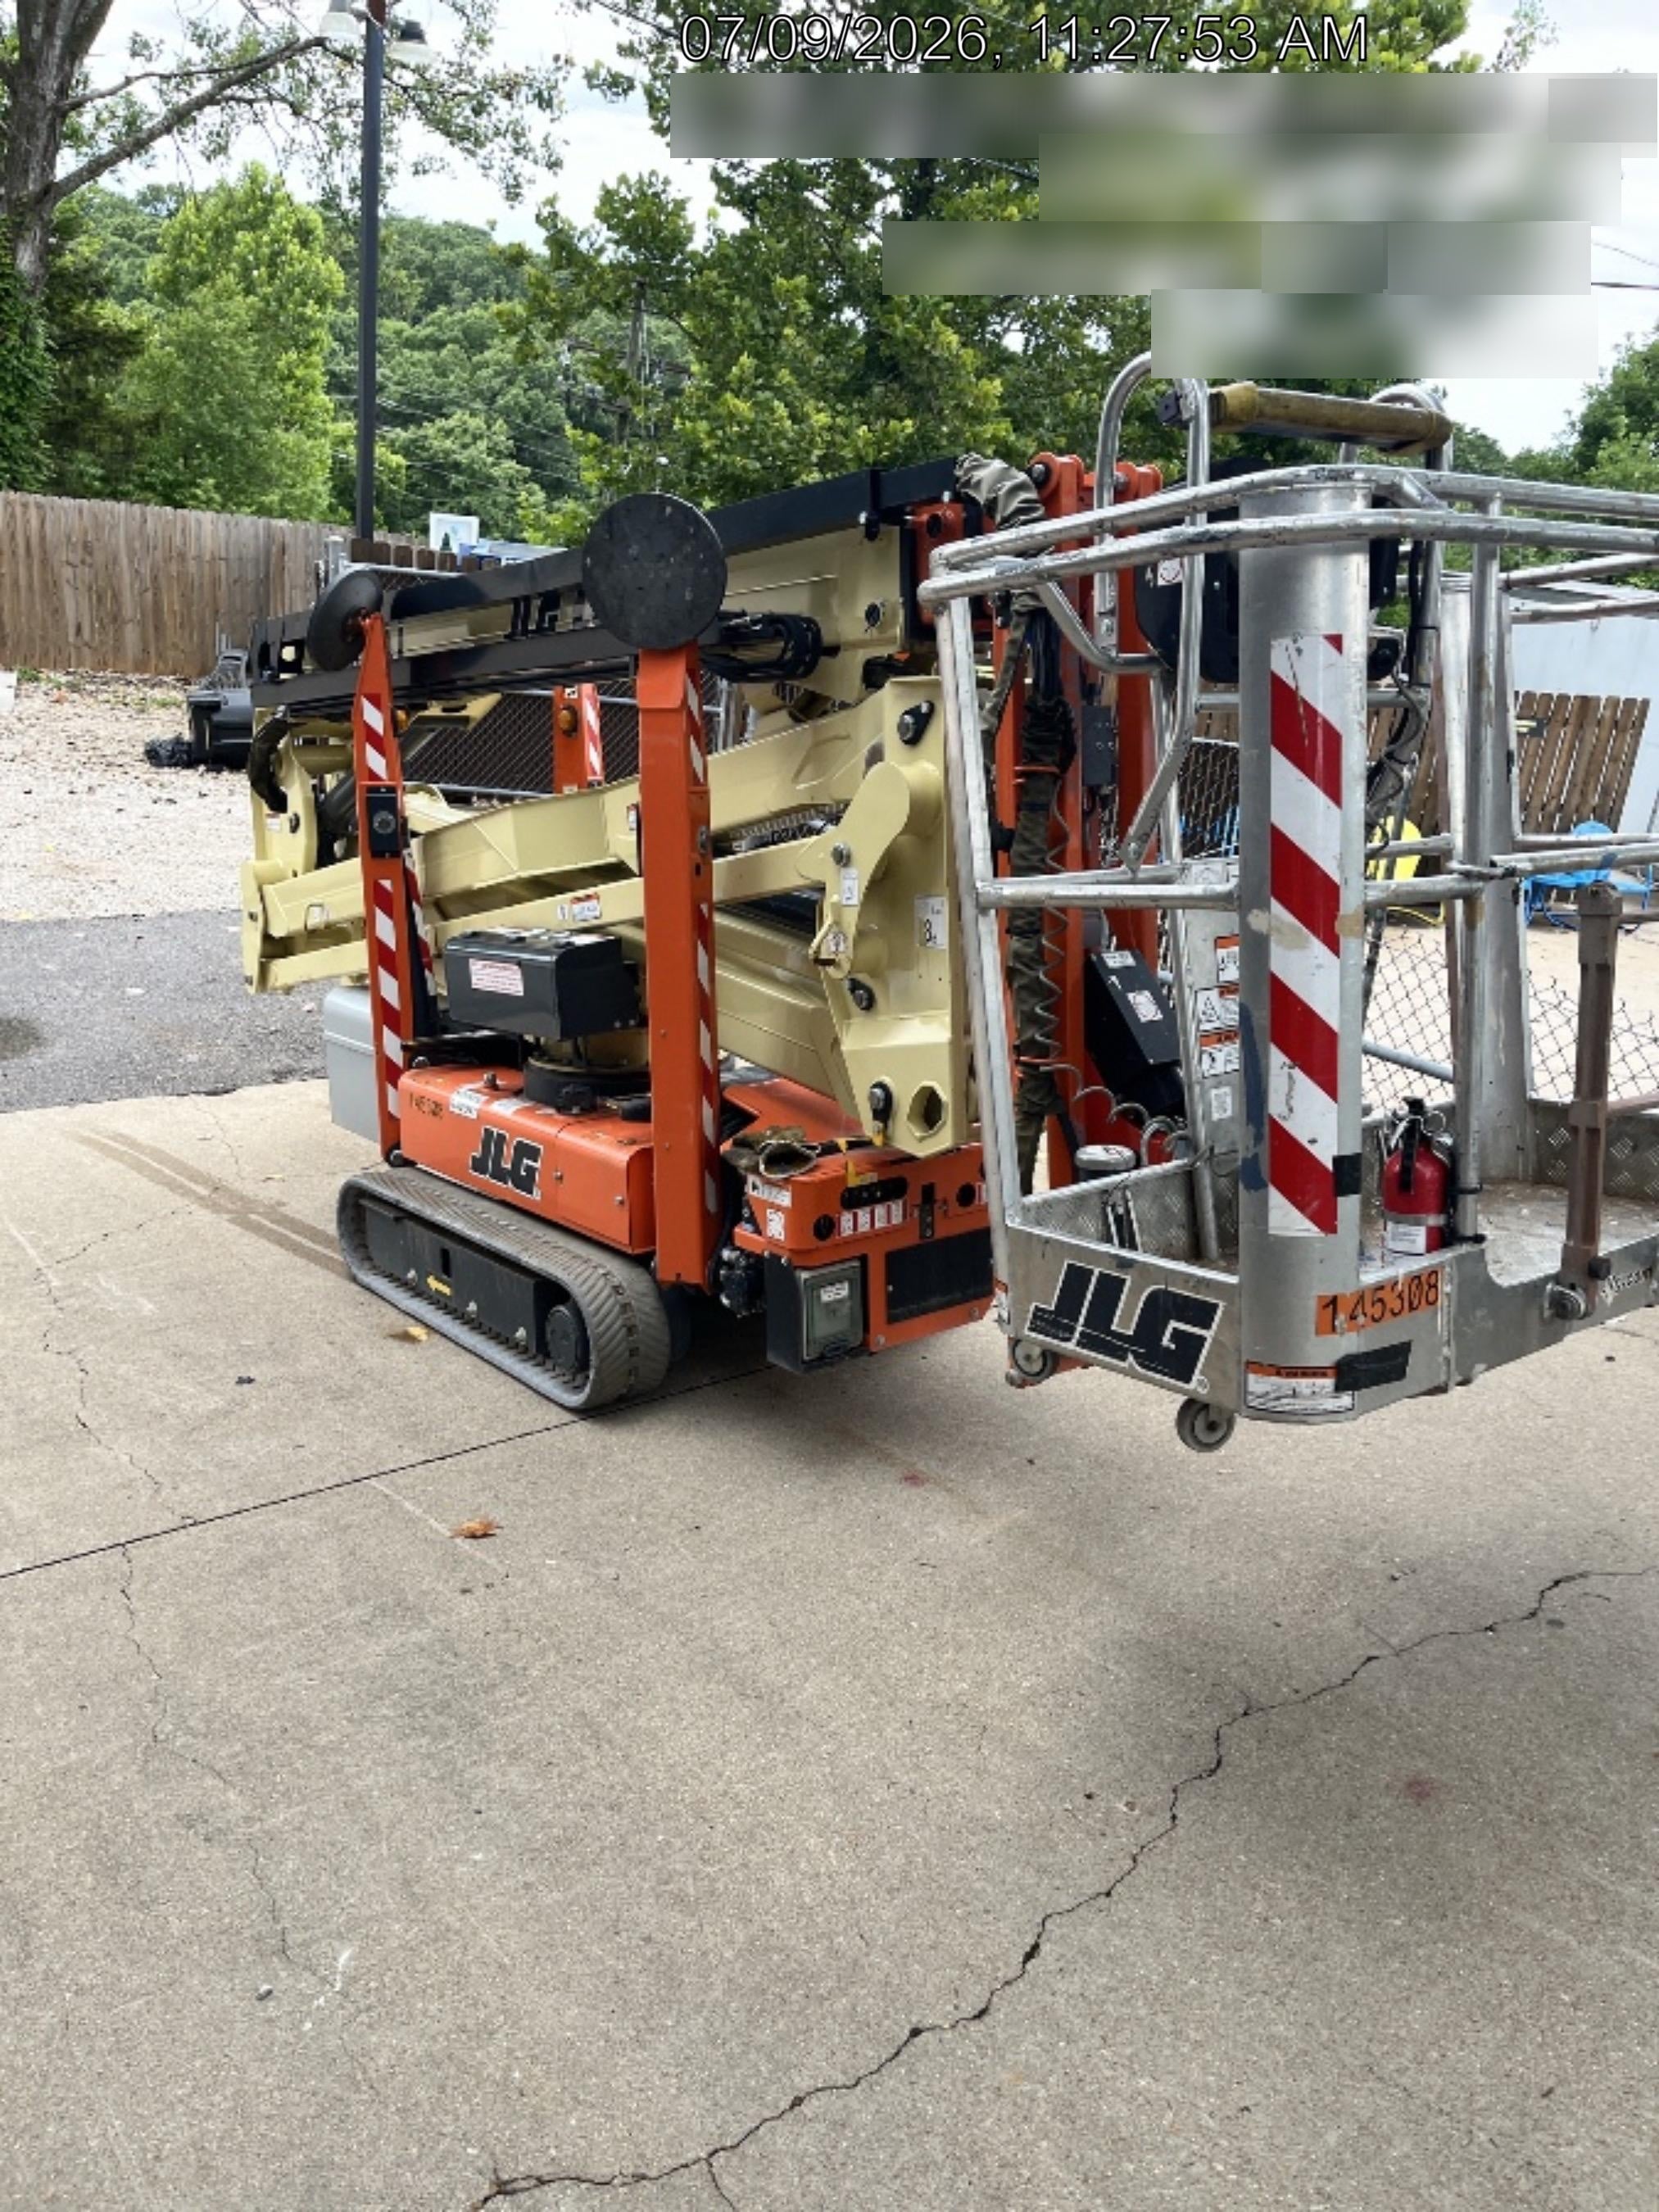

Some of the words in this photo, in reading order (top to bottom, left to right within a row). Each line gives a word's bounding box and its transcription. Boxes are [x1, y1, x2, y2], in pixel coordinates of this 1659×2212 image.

[469, 1126, 543, 1199] JLG
[1025, 1259, 1226, 1389] JLG
[1321, 1270, 1439, 1332] 145308
